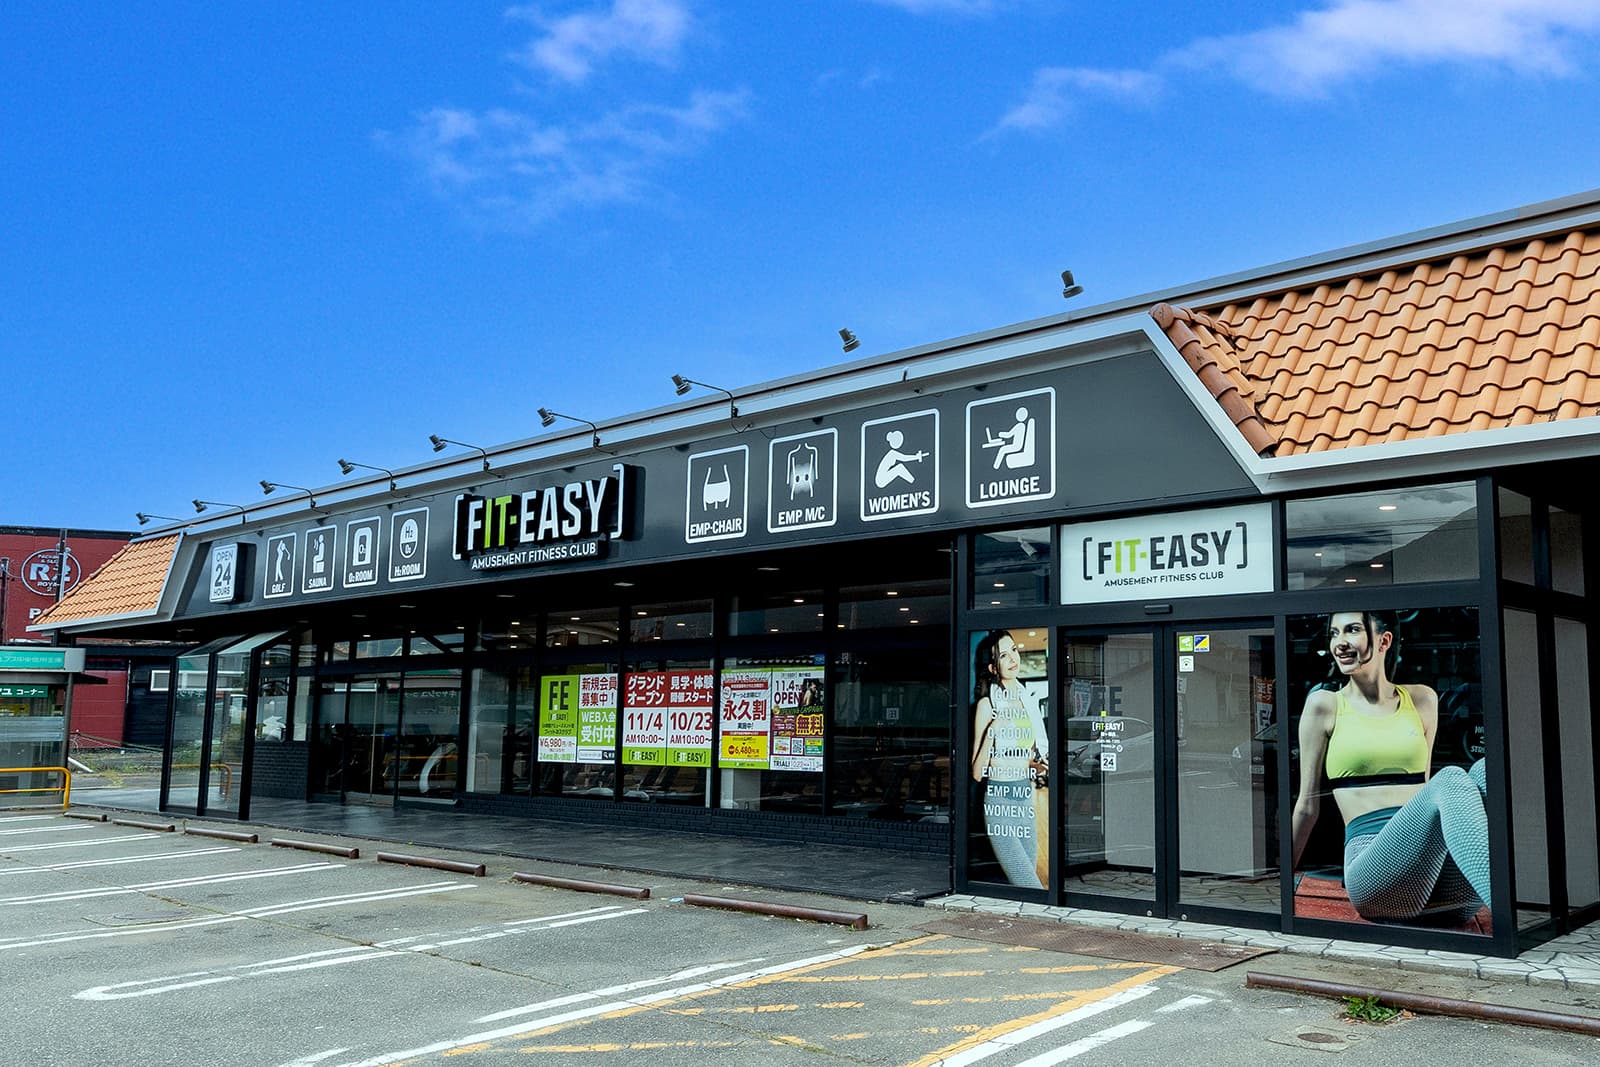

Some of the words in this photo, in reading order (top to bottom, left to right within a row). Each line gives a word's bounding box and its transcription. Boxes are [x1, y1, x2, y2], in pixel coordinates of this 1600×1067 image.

[979, 475, 1041, 500] LOUNGE
[868, 490, 932, 513] WOMEN'S
[778, 511, 803, 526] EMP
[804, 505, 826, 522] M/C
[216, 550, 234, 563] OPEN
[471, 552, 526, 571] AMUSEMENT
[528, 548, 568, 563] FITNESS
[569, 541, 597, 556] CLUB
[214, 562, 231, 588] 24
[308, 576, 328, 588] SAUNA
[1104, 577, 1157, 588] AMUSEMENT
[1159, 574, 1196, 584] FITNESS
[1199, 570, 1224, 581] CLUB
[212, 586, 231, 597] HOURS
[271, 582, 287, 594] GOLF
[582, 676, 617, 691] 新規会員
[628, 675, 666, 690] グランド
[775, 680, 796, 692] 11.4
[16, 688, 45, 696] コーナー
[627, 690, 665, 705] オープン
[773, 691, 802, 705] OPEN
[581, 711, 616, 723] WEB入会
[723, 699, 767, 721] 永久割
[991, 708, 1028, 720] SAUNA
[628, 712, 663, 731] 11/4
[670, 711, 713, 731] 10/23
[797, 714, 823, 736] 無料
[581, 725, 616, 744] 受付中
[1103, 757, 1115, 767] 24
[987, 785, 1010, 797] EMP
[1012, 786, 1031, 799] M/C
[983, 804, 1035, 819] WOMEN'S
[987, 824, 1031, 839] LOUNGE
